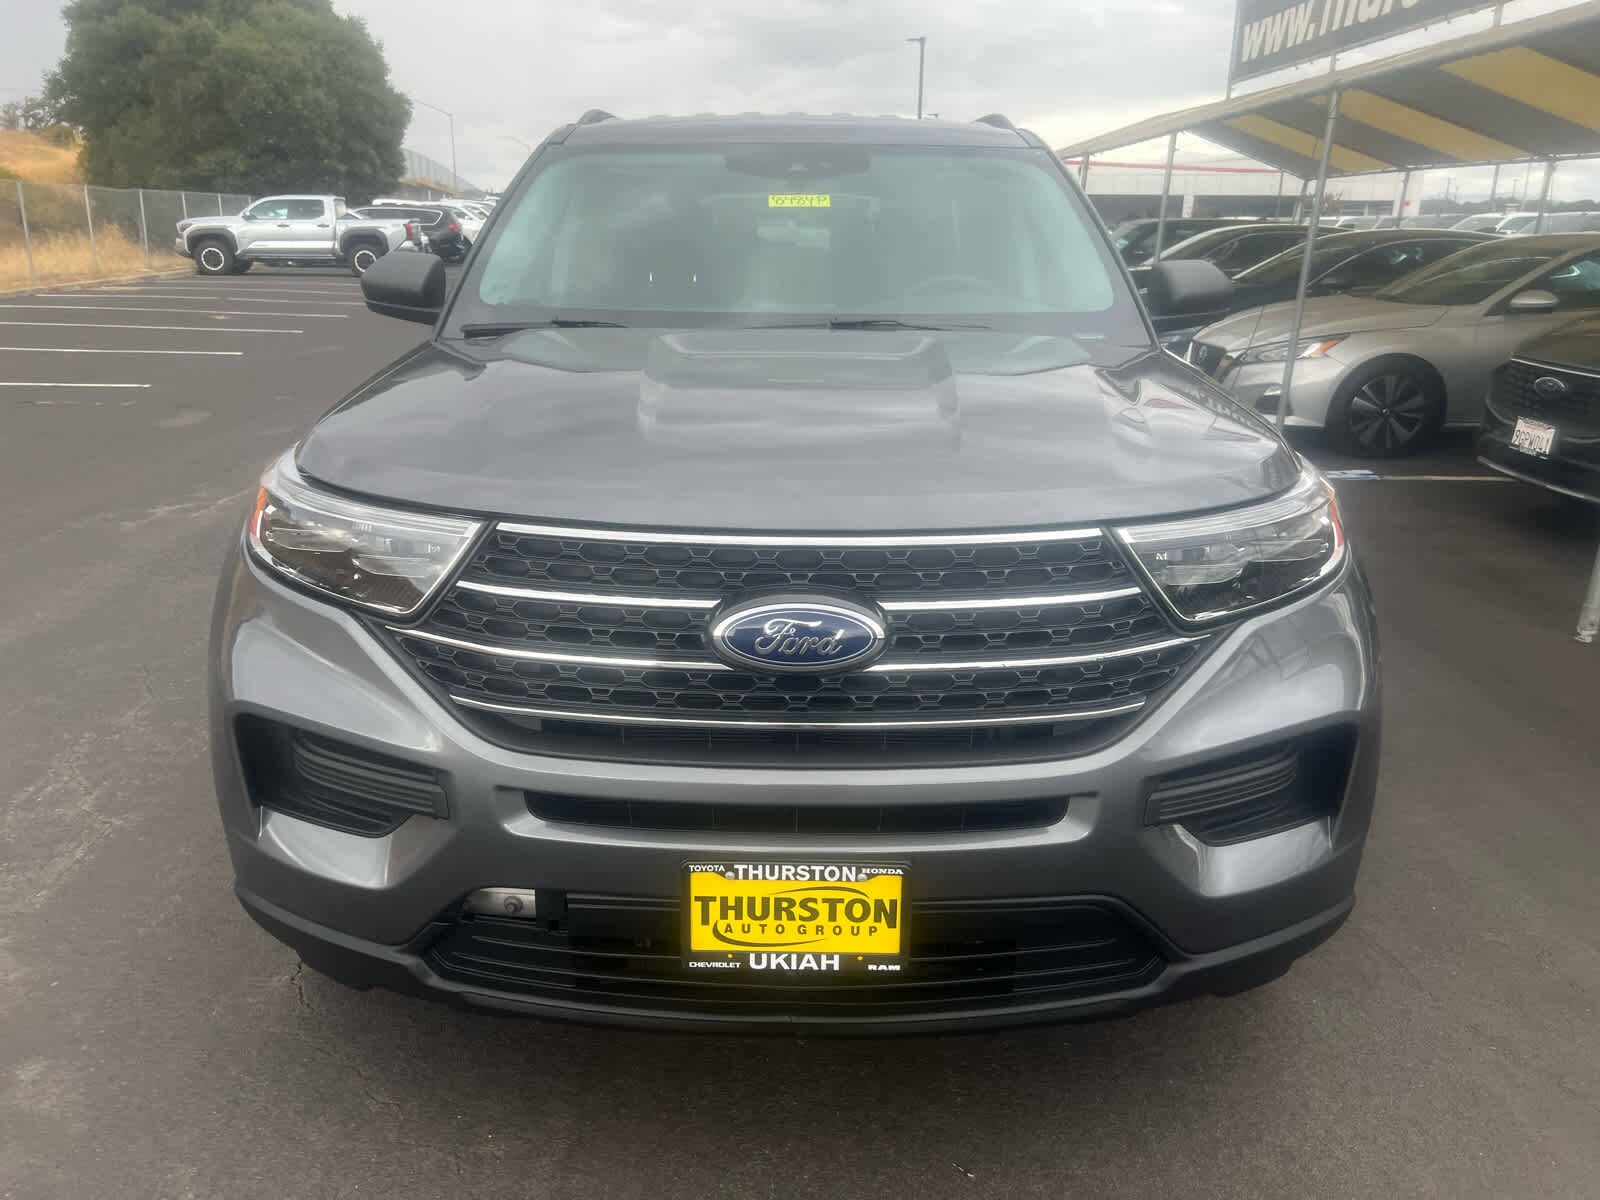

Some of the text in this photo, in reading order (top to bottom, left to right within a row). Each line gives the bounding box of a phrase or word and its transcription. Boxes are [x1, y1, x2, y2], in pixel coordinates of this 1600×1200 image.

[755, 618, 845, 656] Ford
[689, 864, 726, 872] TOYOTA
[734, 864, 856, 882] THURSTON
[862, 867, 904, 875] HONDA
[694, 895, 898, 929] THURSTON
[724, 923, 878, 937] AUTO GROUP
[749, 952, 840, 971] UKIAH
